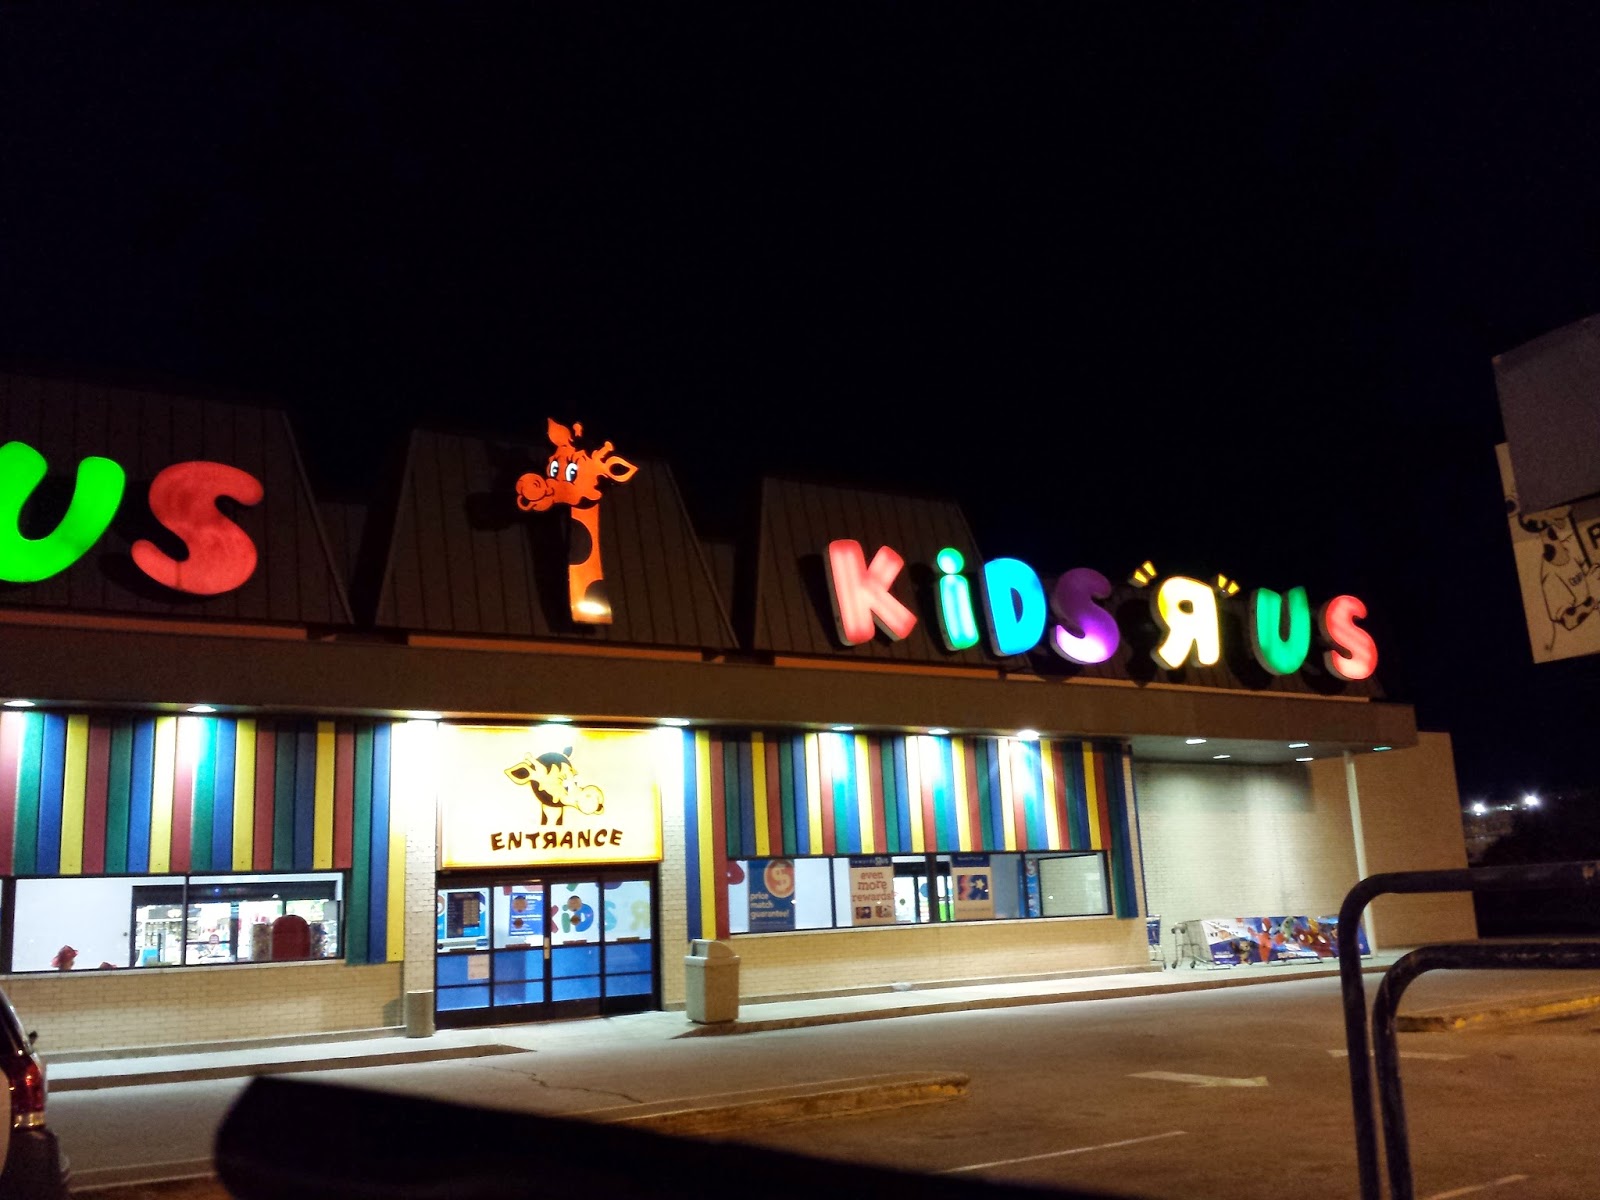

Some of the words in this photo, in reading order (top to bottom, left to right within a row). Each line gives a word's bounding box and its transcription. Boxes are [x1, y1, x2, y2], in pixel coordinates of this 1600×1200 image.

[0, 441, 263, 595] US
[1252, 586, 1378, 680] US
[490, 828, 623, 851] ENTRANCE
[857, 880, 888, 891] more
[861, 872, 884, 880] even
